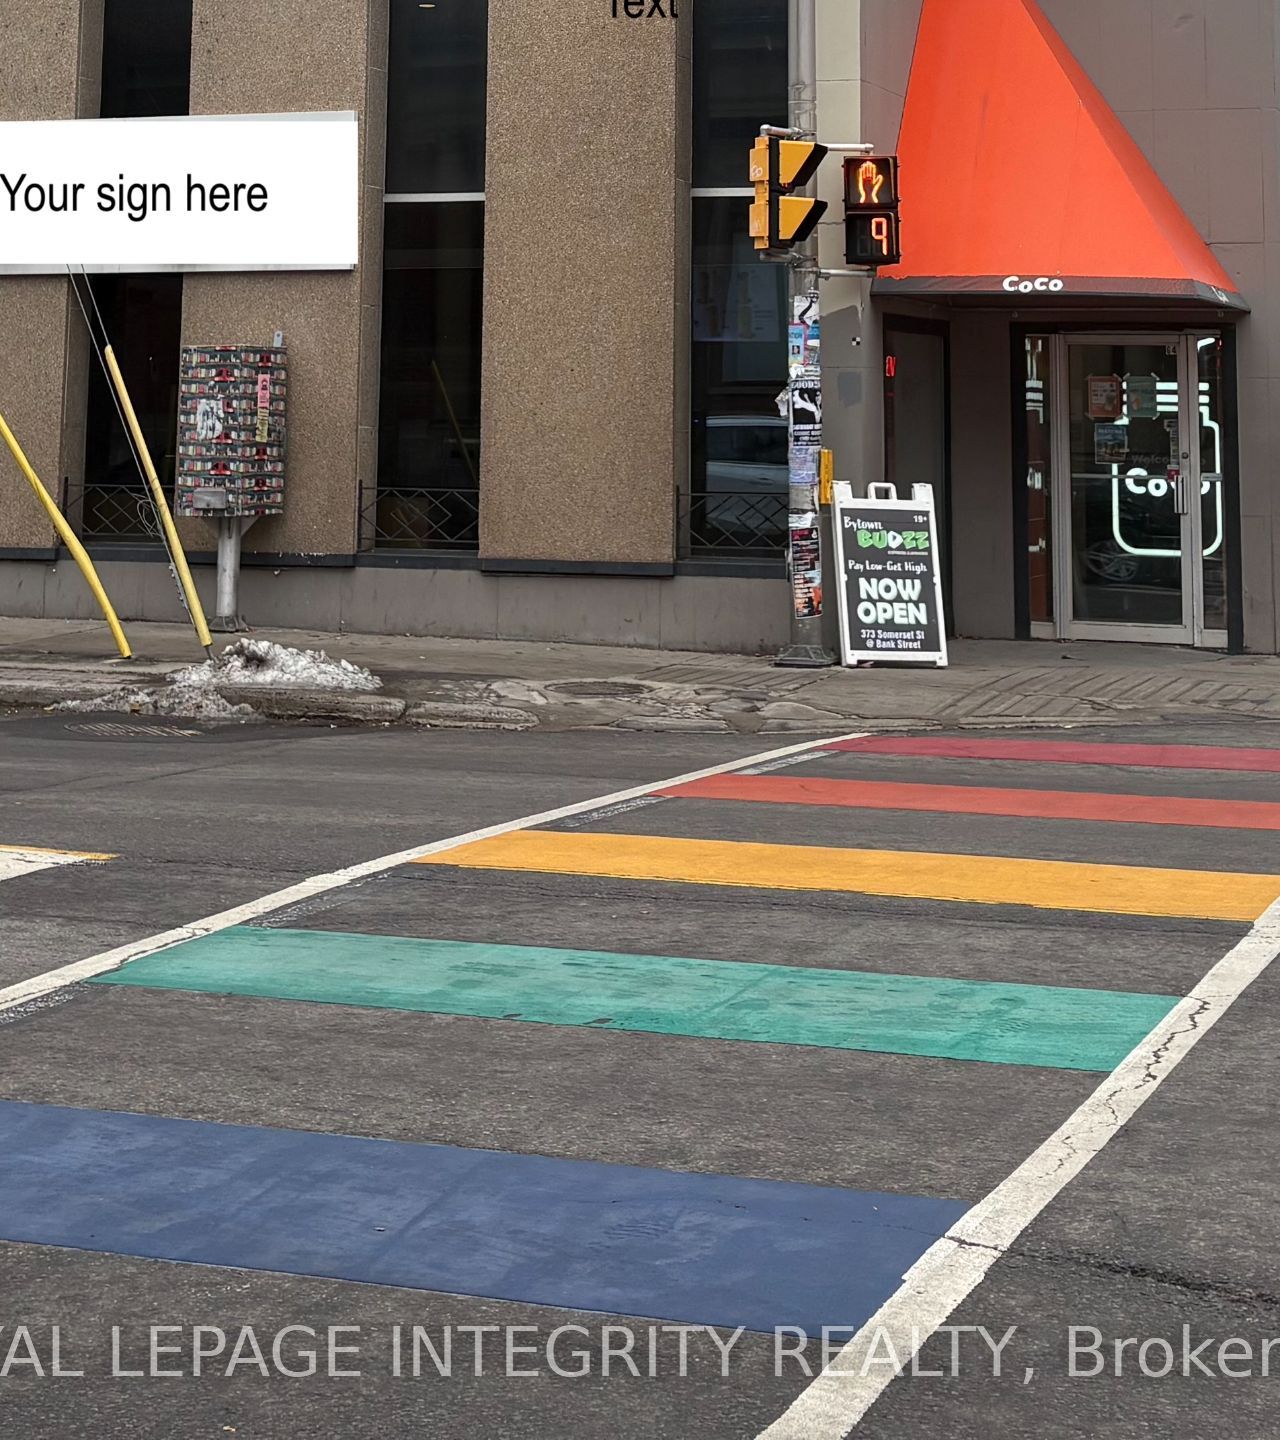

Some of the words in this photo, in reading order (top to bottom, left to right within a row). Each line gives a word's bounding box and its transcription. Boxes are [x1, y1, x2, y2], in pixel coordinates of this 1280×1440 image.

[871, 217, 888, 256] 9
[843, 515, 883, 532] Bytown
[856, 529, 929, 550] BUDZZ
[848, 560, 864, 573] Pay
[858, 577, 922, 601] NOW
[856, 601, 929, 625] OPEN
[860, 629, 876, 639] 373
[877, 630, 915, 640] Somerset
[915, 630, 925, 640] St
[866, 639, 875, 649] @
[876, 639, 896, 649] Bank
[897, 640, 921, 649] Street
